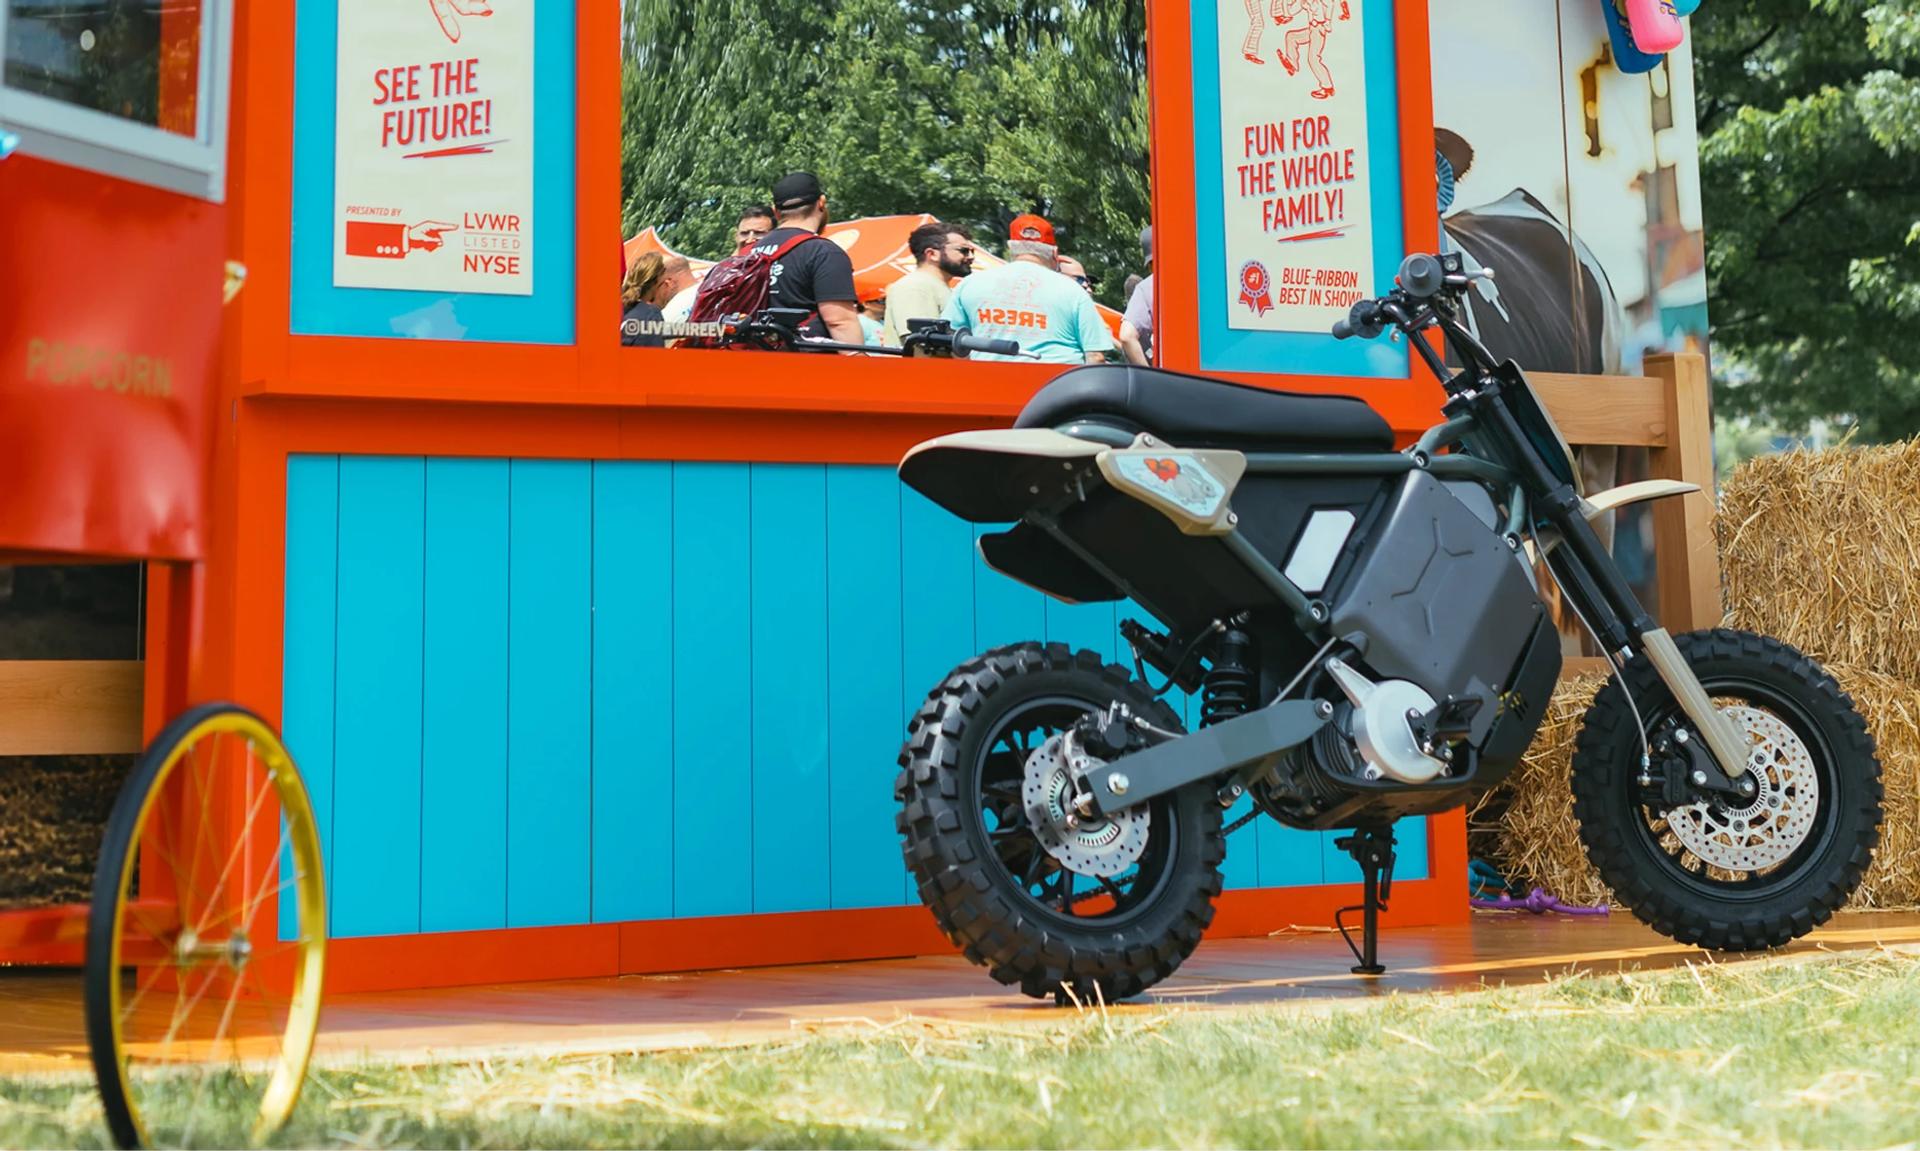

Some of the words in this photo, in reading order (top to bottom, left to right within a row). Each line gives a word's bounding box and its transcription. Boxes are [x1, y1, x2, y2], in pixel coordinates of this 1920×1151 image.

[373, 65, 421, 105] SEE
[430, 58, 479, 98] THE
[382, 99, 491, 147] FUTURE!
[1245, 121, 1284, 158] FUN
[1292, 115, 1330, 150] FOR
[1237, 161, 1276, 197] THE
[1282, 148, 1354, 190] WHOLE
[346, 206, 389, 216] PRESENTED
[391, 208, 402, 217] BY
[464, 212, 520, 232] LVWR
[1263, 188, 1344, 232] FAMILY!
[464, 236, 521, 249] LISTED
[464, 254, 520, 275] NYSE
[1282, 267, 1359, 288] BLUE-RIBBON
[1280, 287, 1307, 305] BEST
[1309, 289, 1321, 305] IN
[25, 336, 172, 398] POPCORN
